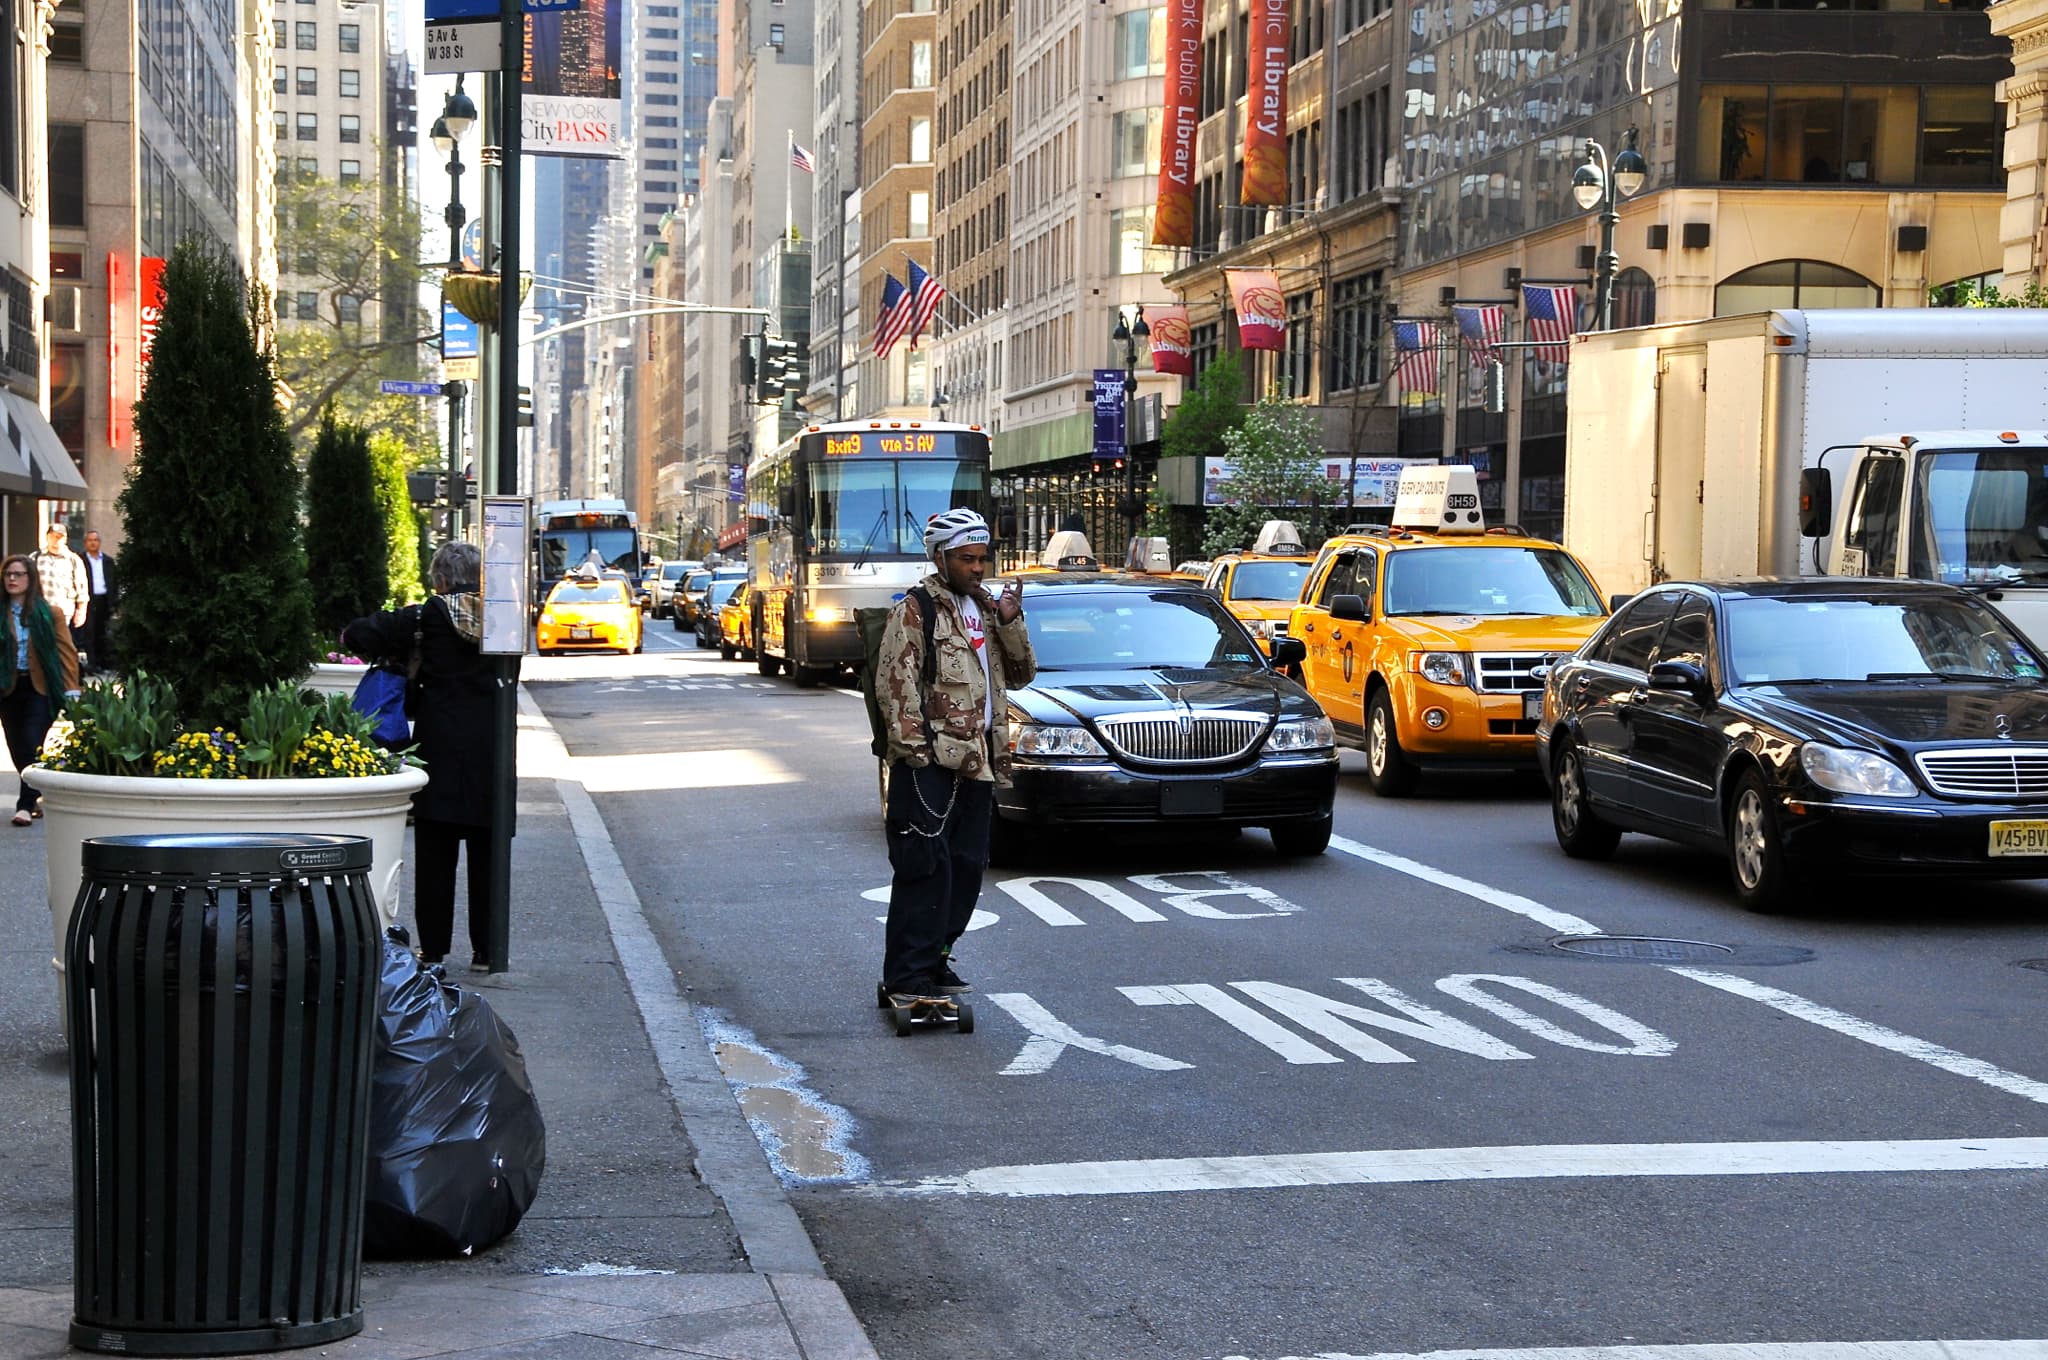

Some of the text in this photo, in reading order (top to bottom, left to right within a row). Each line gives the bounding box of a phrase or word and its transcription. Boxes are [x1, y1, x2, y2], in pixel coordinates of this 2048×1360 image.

[428, 28, 458, 43] 5 Av &
[428, 46, 463, 59] W 38 St
[1179, 38, 1197, 97] Public
[1257, 47, 1284, 137] Library
[523, 101, 607, 120] NEW YORK
[521, 119, 608, 145] CityPASS
[1169, 105, 1194, 186] Library
[384, 382, 408, 392] West
[827, 434, 935, 454] BxM9 VIA 5 AV
[985, 973, 1679, 1075] ONLY
